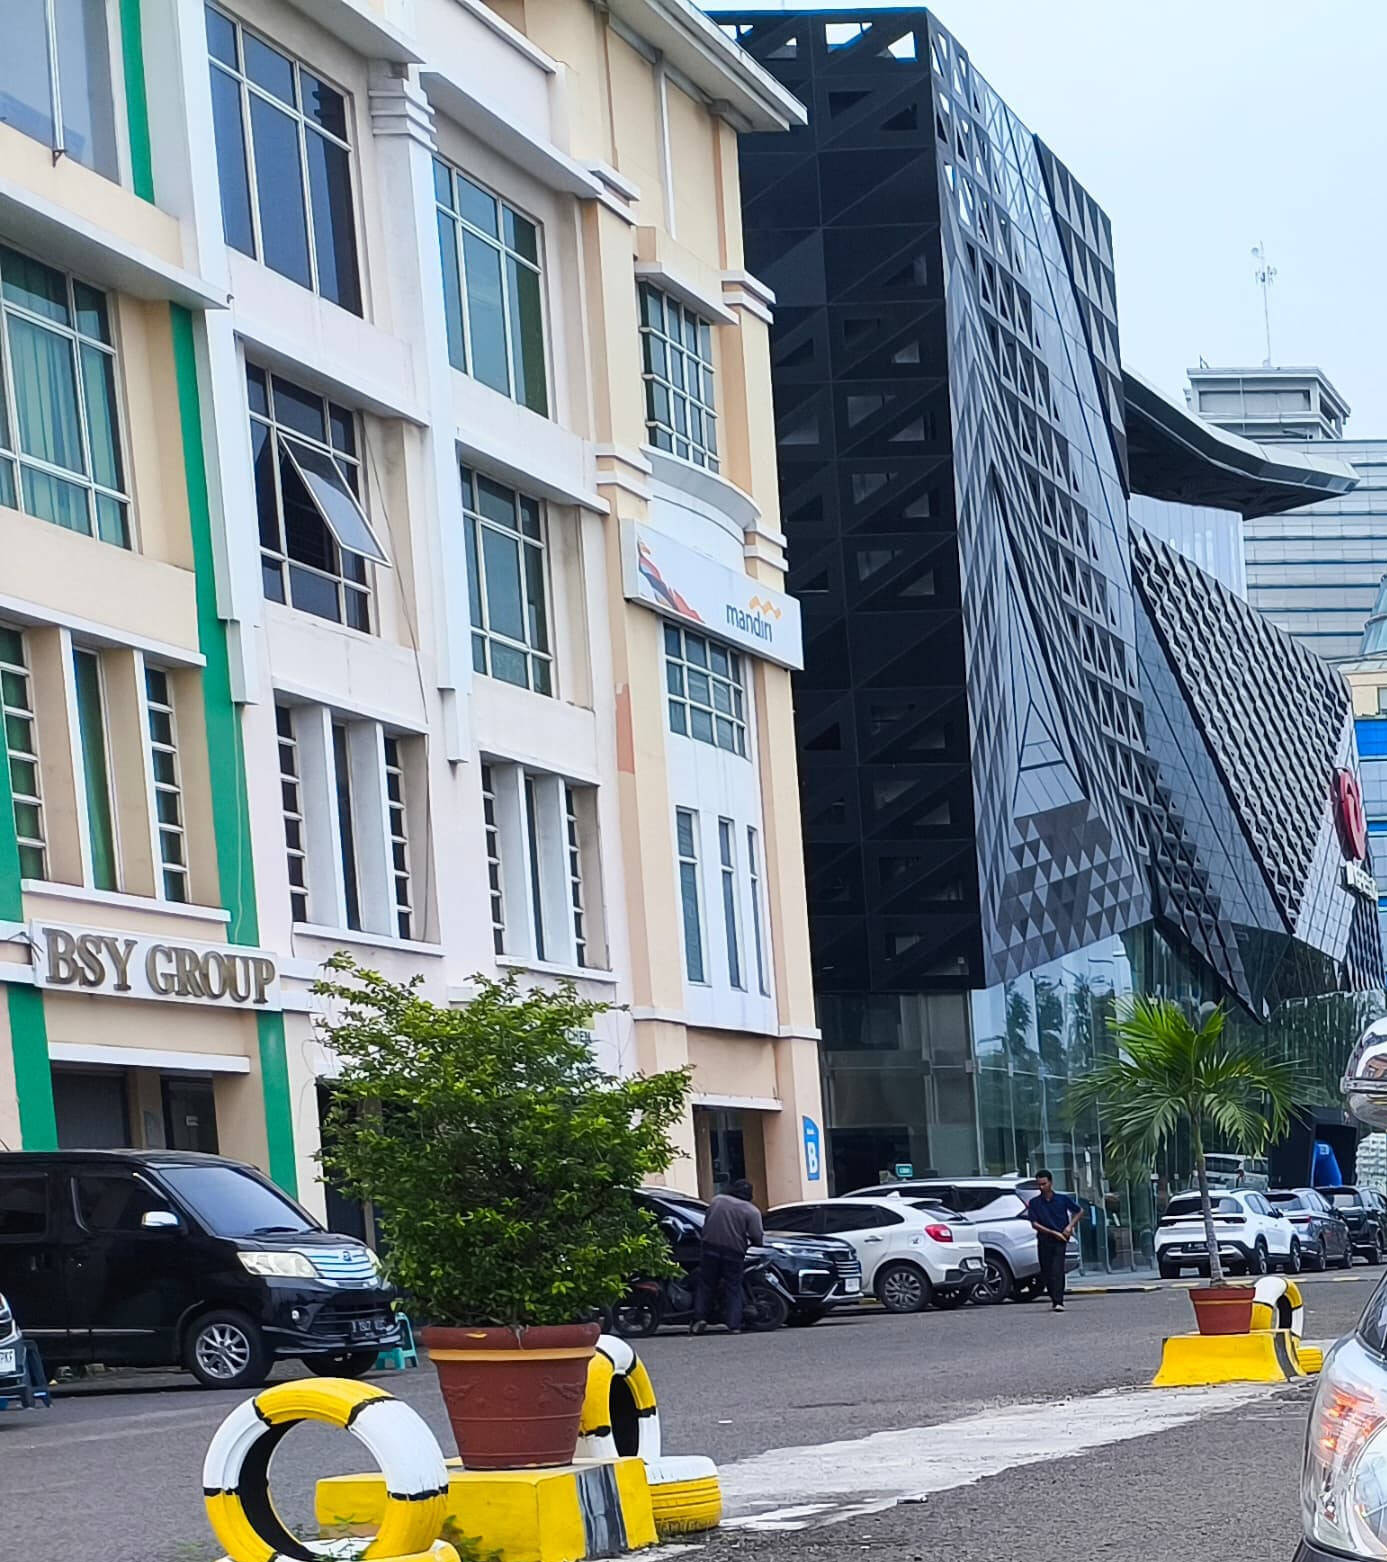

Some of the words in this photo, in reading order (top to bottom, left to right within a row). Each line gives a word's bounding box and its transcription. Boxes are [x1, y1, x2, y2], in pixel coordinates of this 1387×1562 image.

[42, 927, 138, 991] BSY
[145, 943, 276, 1004] GROUP
[807, 1141, 818, 1173] B
